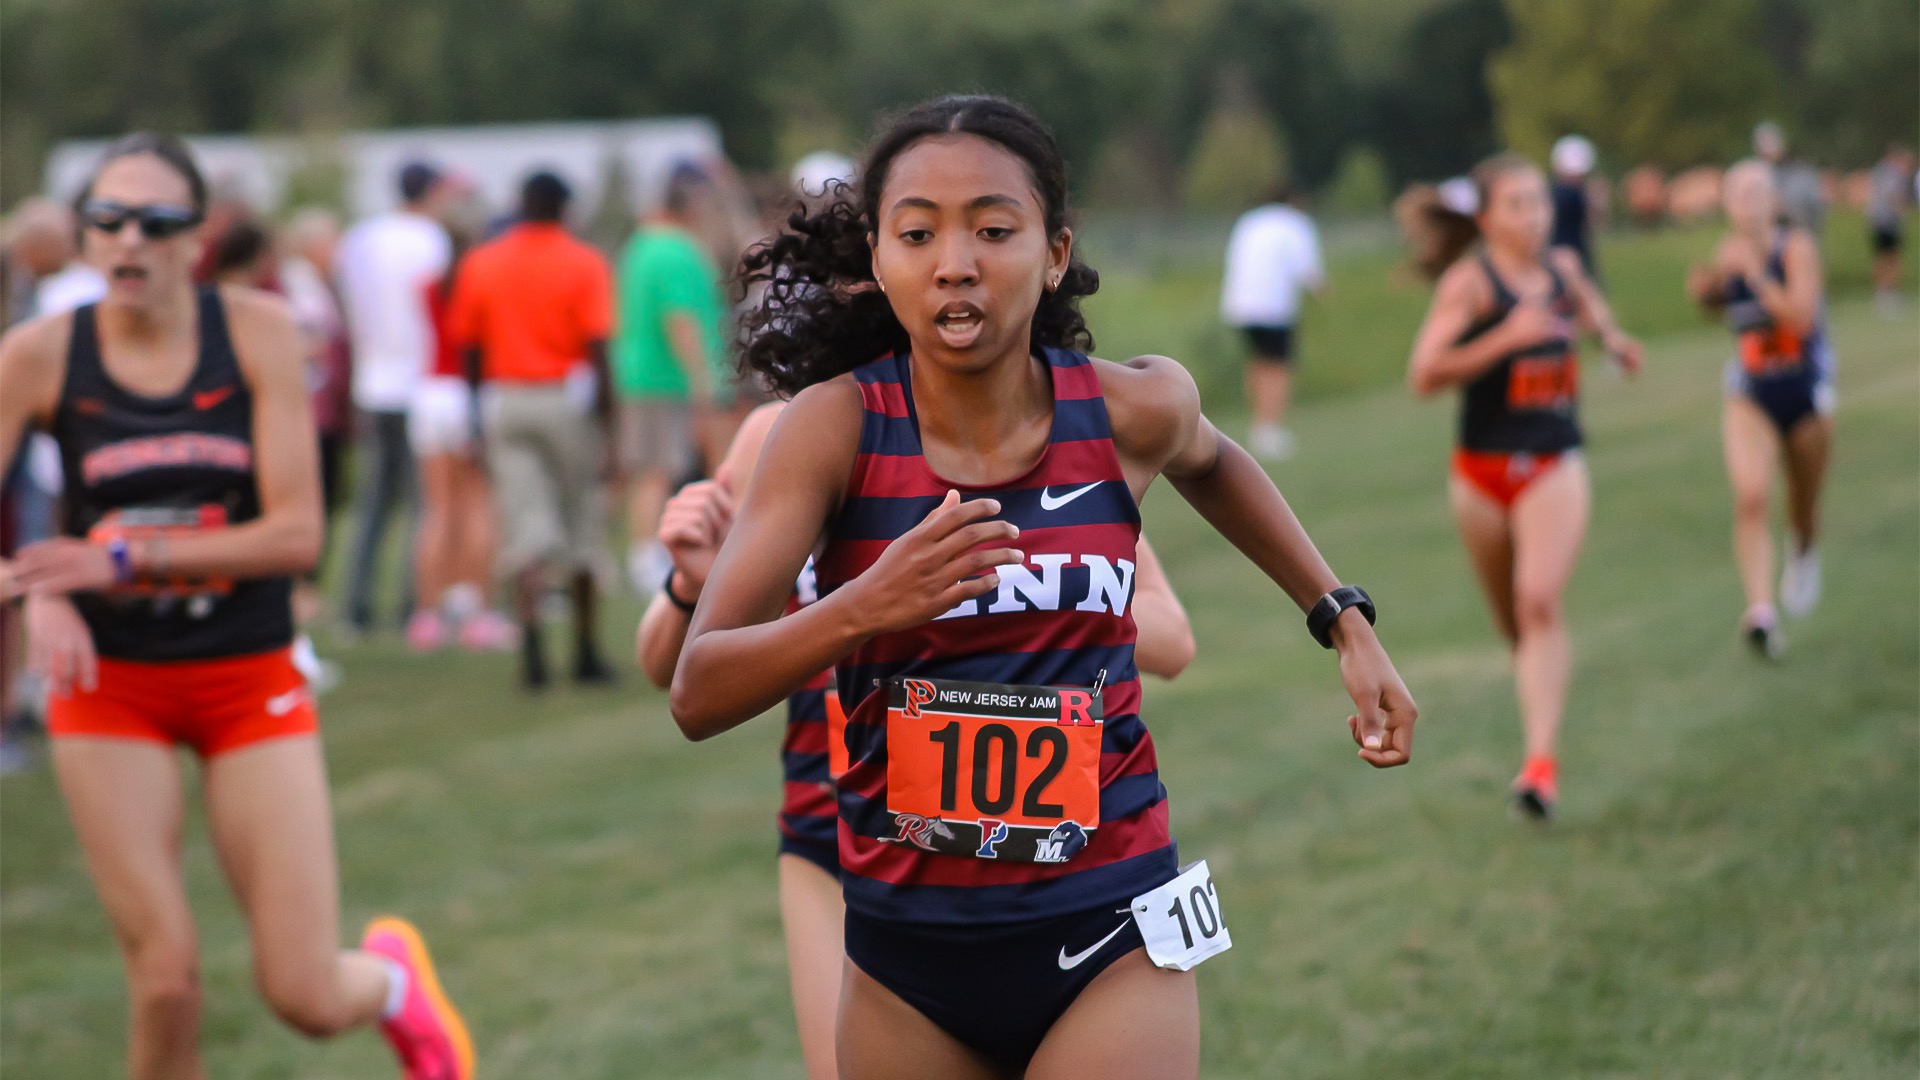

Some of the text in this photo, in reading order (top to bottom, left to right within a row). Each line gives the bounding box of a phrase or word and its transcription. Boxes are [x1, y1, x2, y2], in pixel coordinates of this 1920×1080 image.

[901, 678, 937, 719] P
[940, 690, 1056, 709] NEW JERSEY JAM
[1057, 690, 1096, 727] R
[929, 721, 1068, 819] 102
[976, 818, 1009, 858] P
